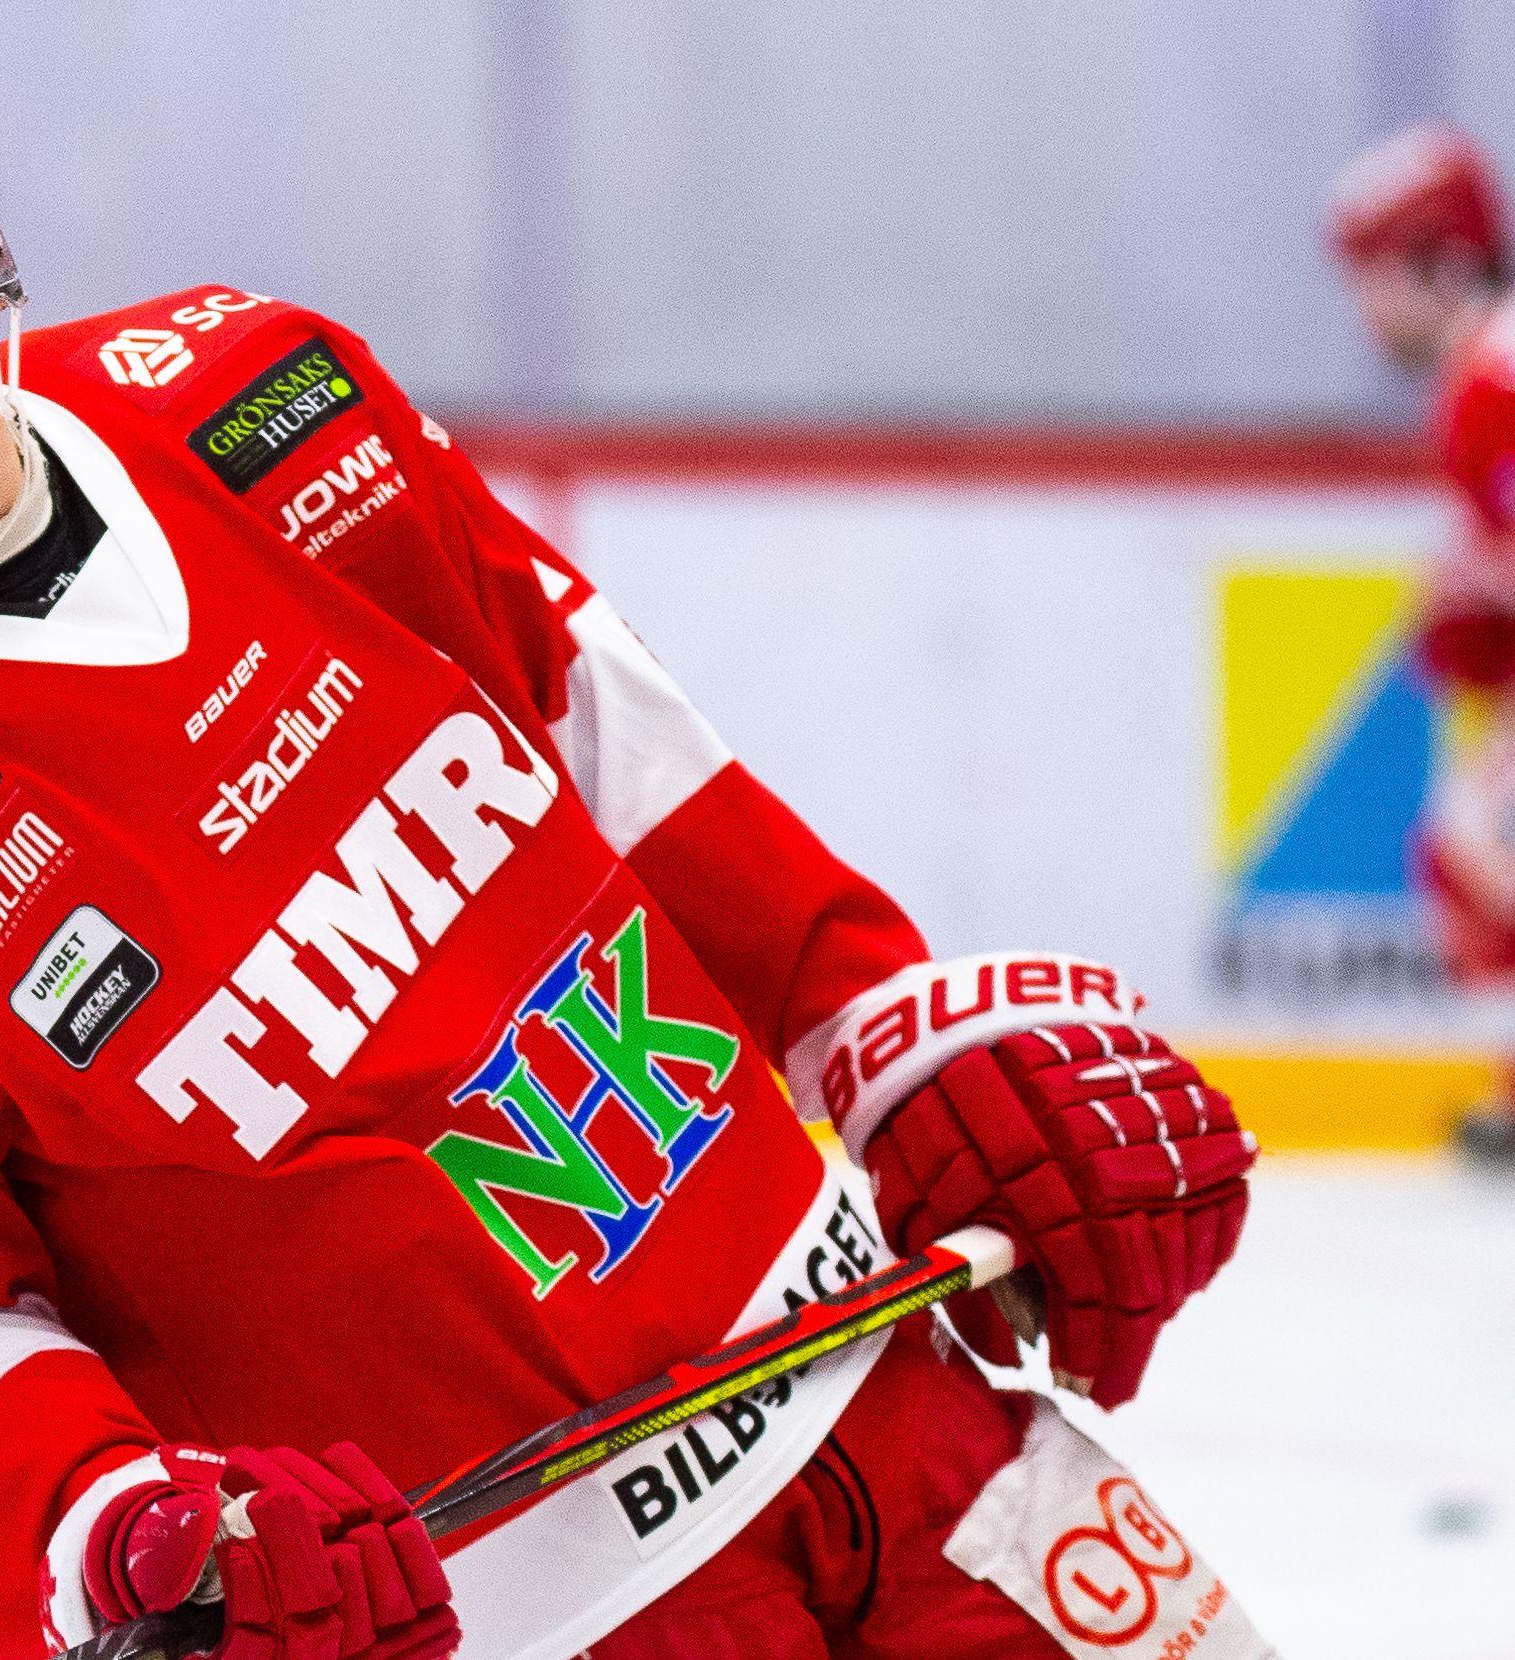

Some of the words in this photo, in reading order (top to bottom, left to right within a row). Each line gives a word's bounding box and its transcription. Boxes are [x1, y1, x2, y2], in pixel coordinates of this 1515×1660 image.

[171, 292, 273, 332] SC
[208, 352, 333, 456] GRÖNSAKS
[258, 380, 337, 449] HUSET
[185, 640, 267, 743] BAUER
[199, 656, 363, 855] stadium
[30, 931, 86, 1001] UNIBET
[134, 680, 559, 1162] TIMR
[69, 963, 127, 1040] HOCKEY
[821, 960, 1124, 1136] BAUER
